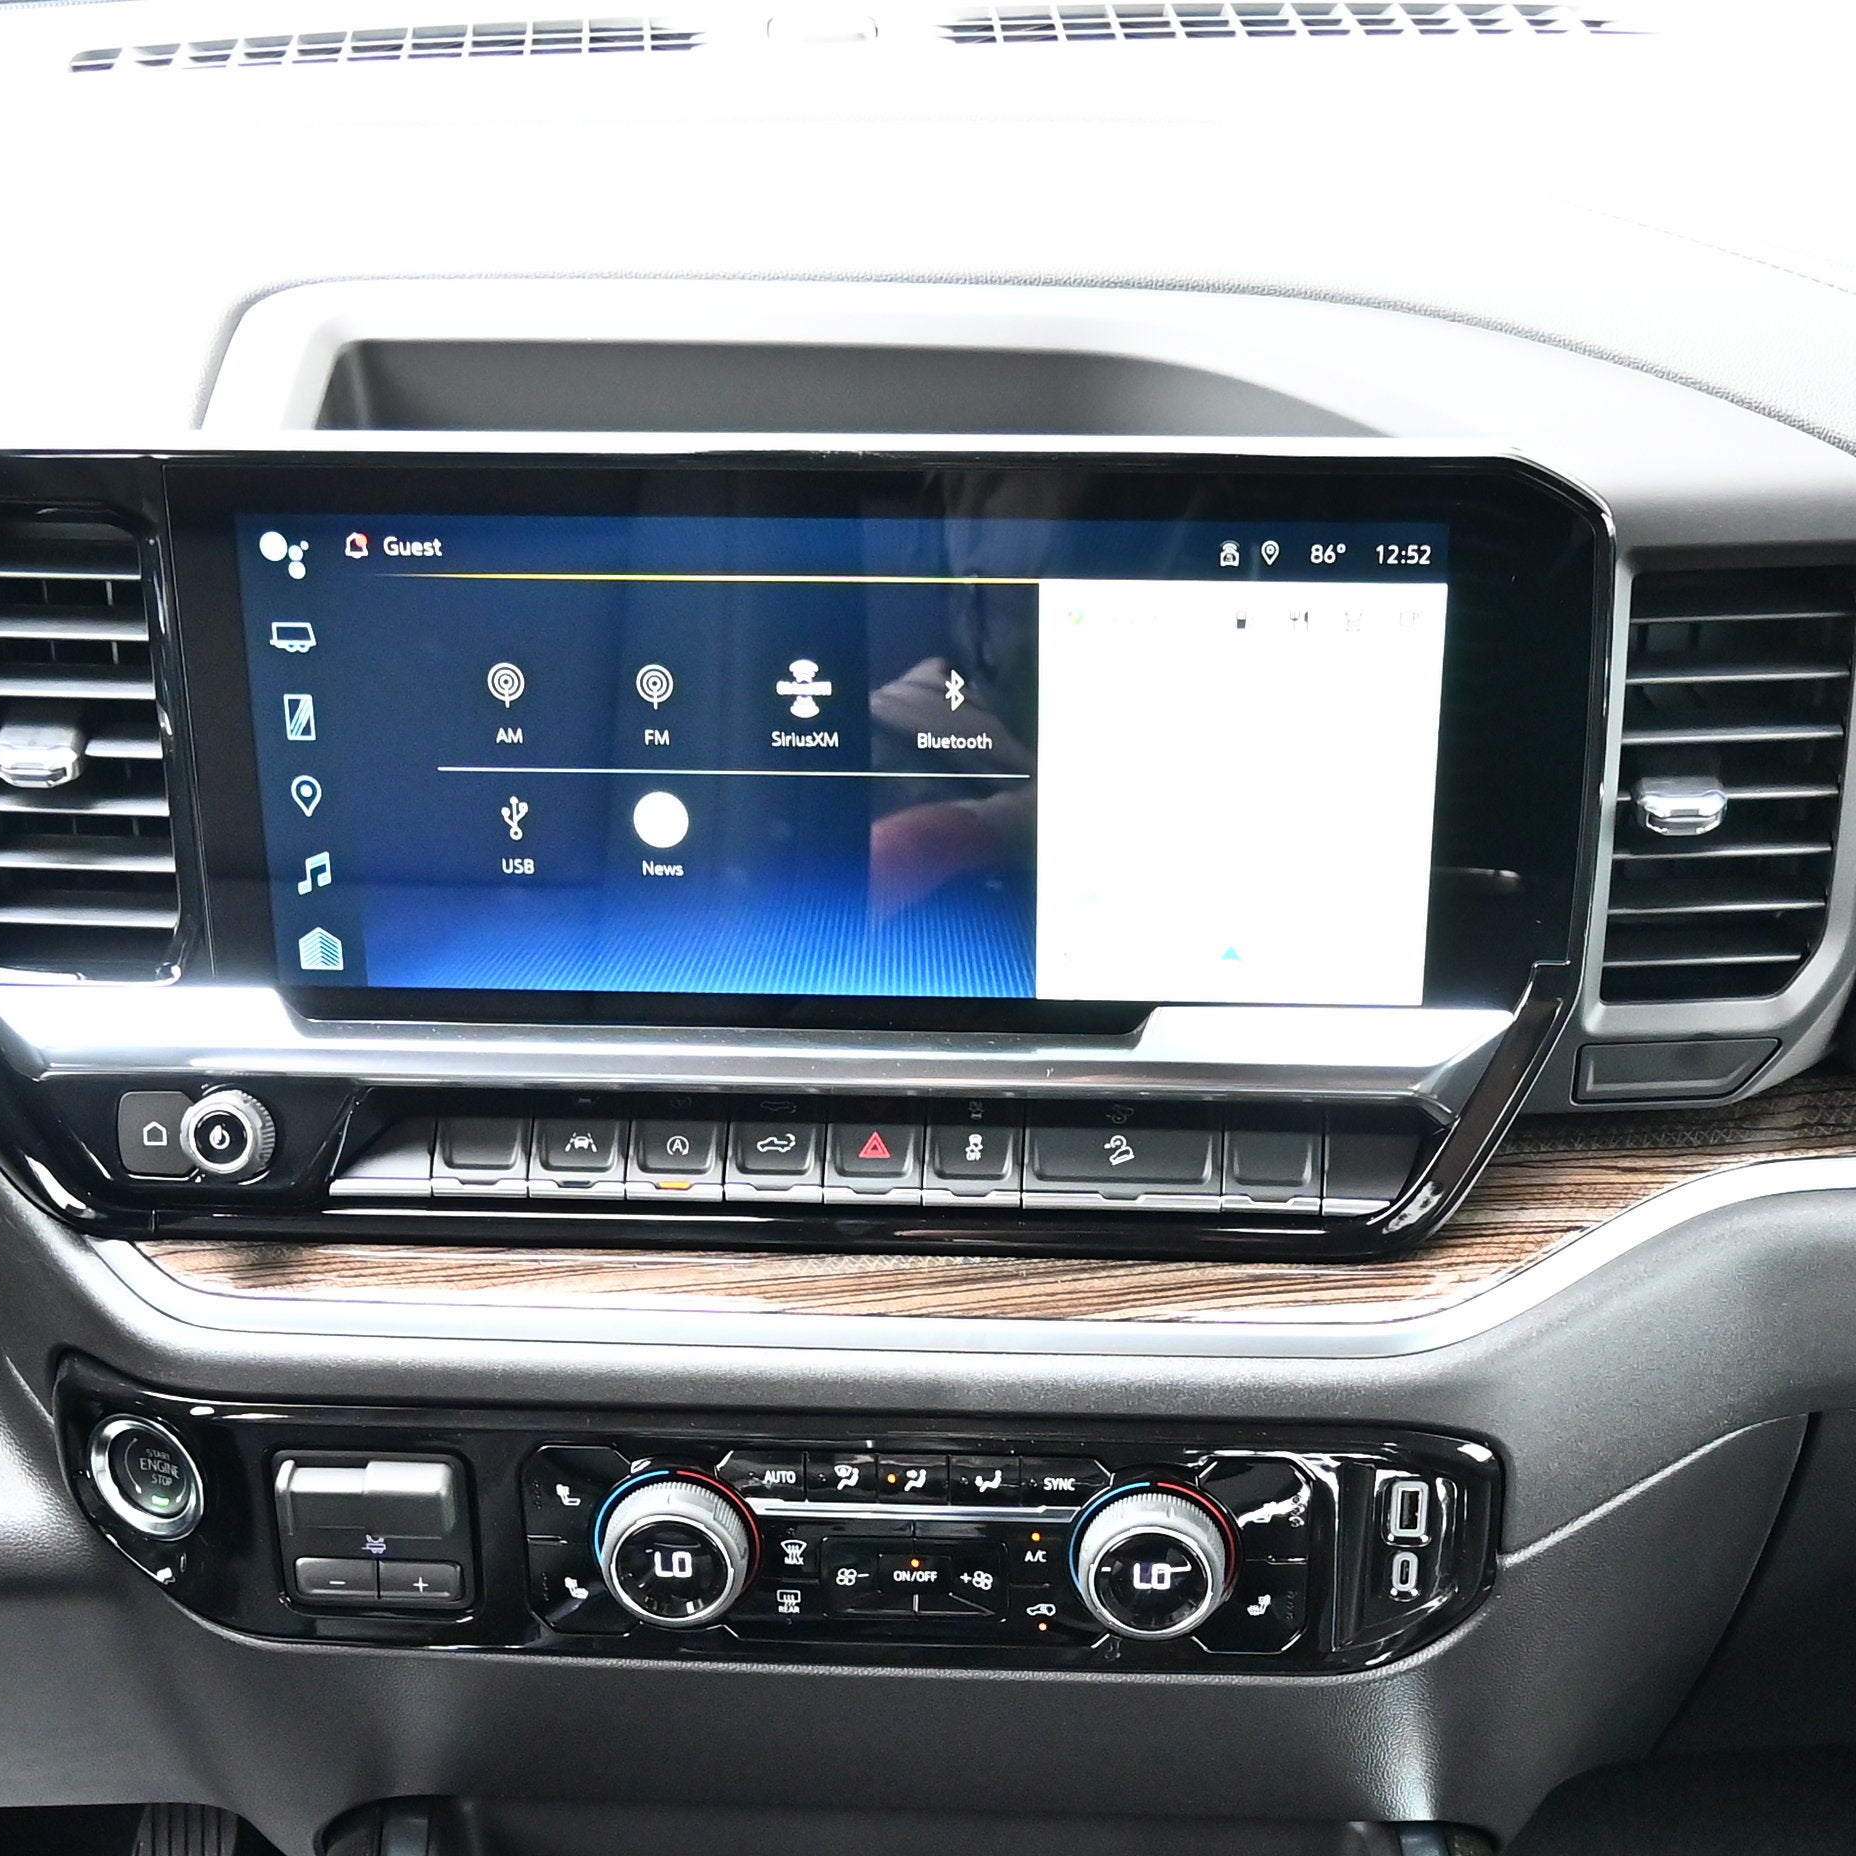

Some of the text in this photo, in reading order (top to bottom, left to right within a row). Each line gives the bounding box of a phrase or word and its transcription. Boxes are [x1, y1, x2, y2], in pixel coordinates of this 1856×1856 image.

[382, 536, 443, 558] Guest
[1376, 544, 1432, 566] 12:52
[496, 728, 524, 745] AM
[644, 729, 670, 746] FM
[771, 731, 839, 748] SiriusXM
[916, 731, 993, 751] Bluetooth
[501, 858, 535, 874] USB
[641, 861, 684, 877] News
[151, 1473, 173, 1486] STOP
[764, 1471, 797, 1484] AUTO
[1043, 1477, 1076, 1492] SYNC
[653, 1551, 693, 1578] LO
[1024, 1550, 1047, 1563] A/C
[893, 1571, 938, 1582] ON/OFF
[1132, 1563, 1171, 1590] LO
[778, 1605, 800, 1614] REAR
